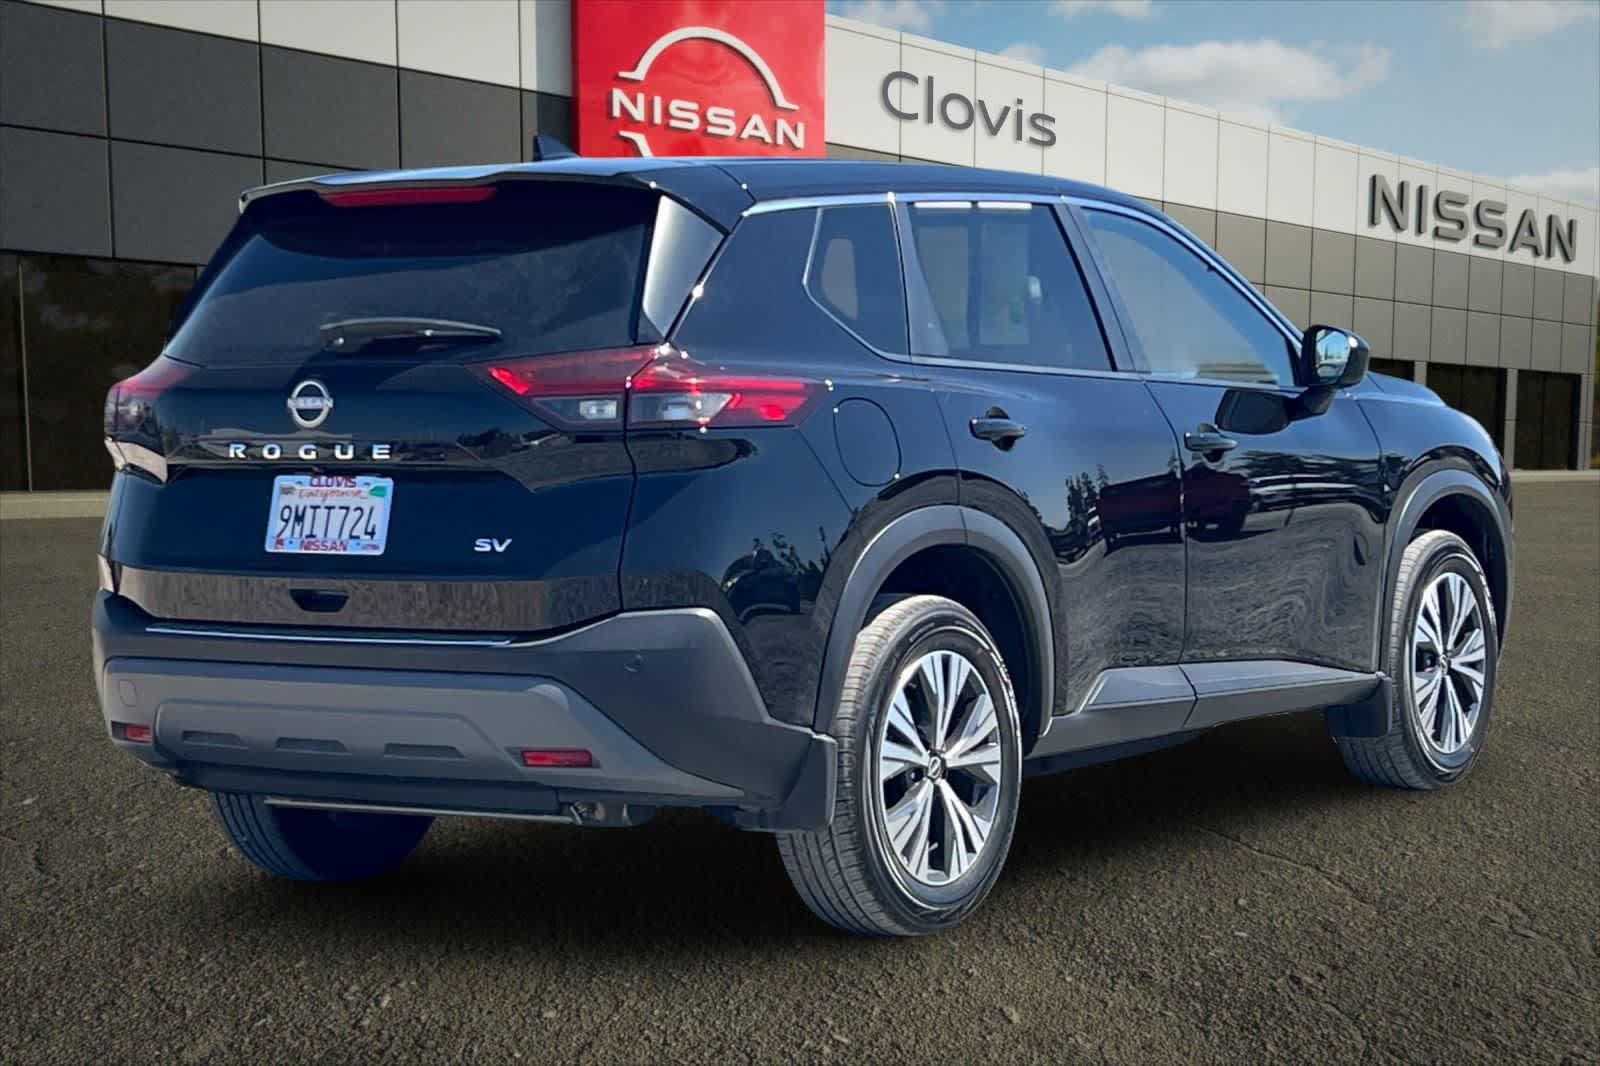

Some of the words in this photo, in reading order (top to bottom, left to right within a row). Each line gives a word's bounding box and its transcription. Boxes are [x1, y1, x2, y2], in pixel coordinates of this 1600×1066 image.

[612, 88, 804, 149] NISSAN
[882, 71, 1057, 147] Clovis
[1368, 174, 1577, 263] NISSAN
[229, 444, 391, 459] ROGUE
[277, 505, 376, 540] 9MIT724
[300, 540, 348, 551] NISSAN
[474, 538, 512, 552] SV
